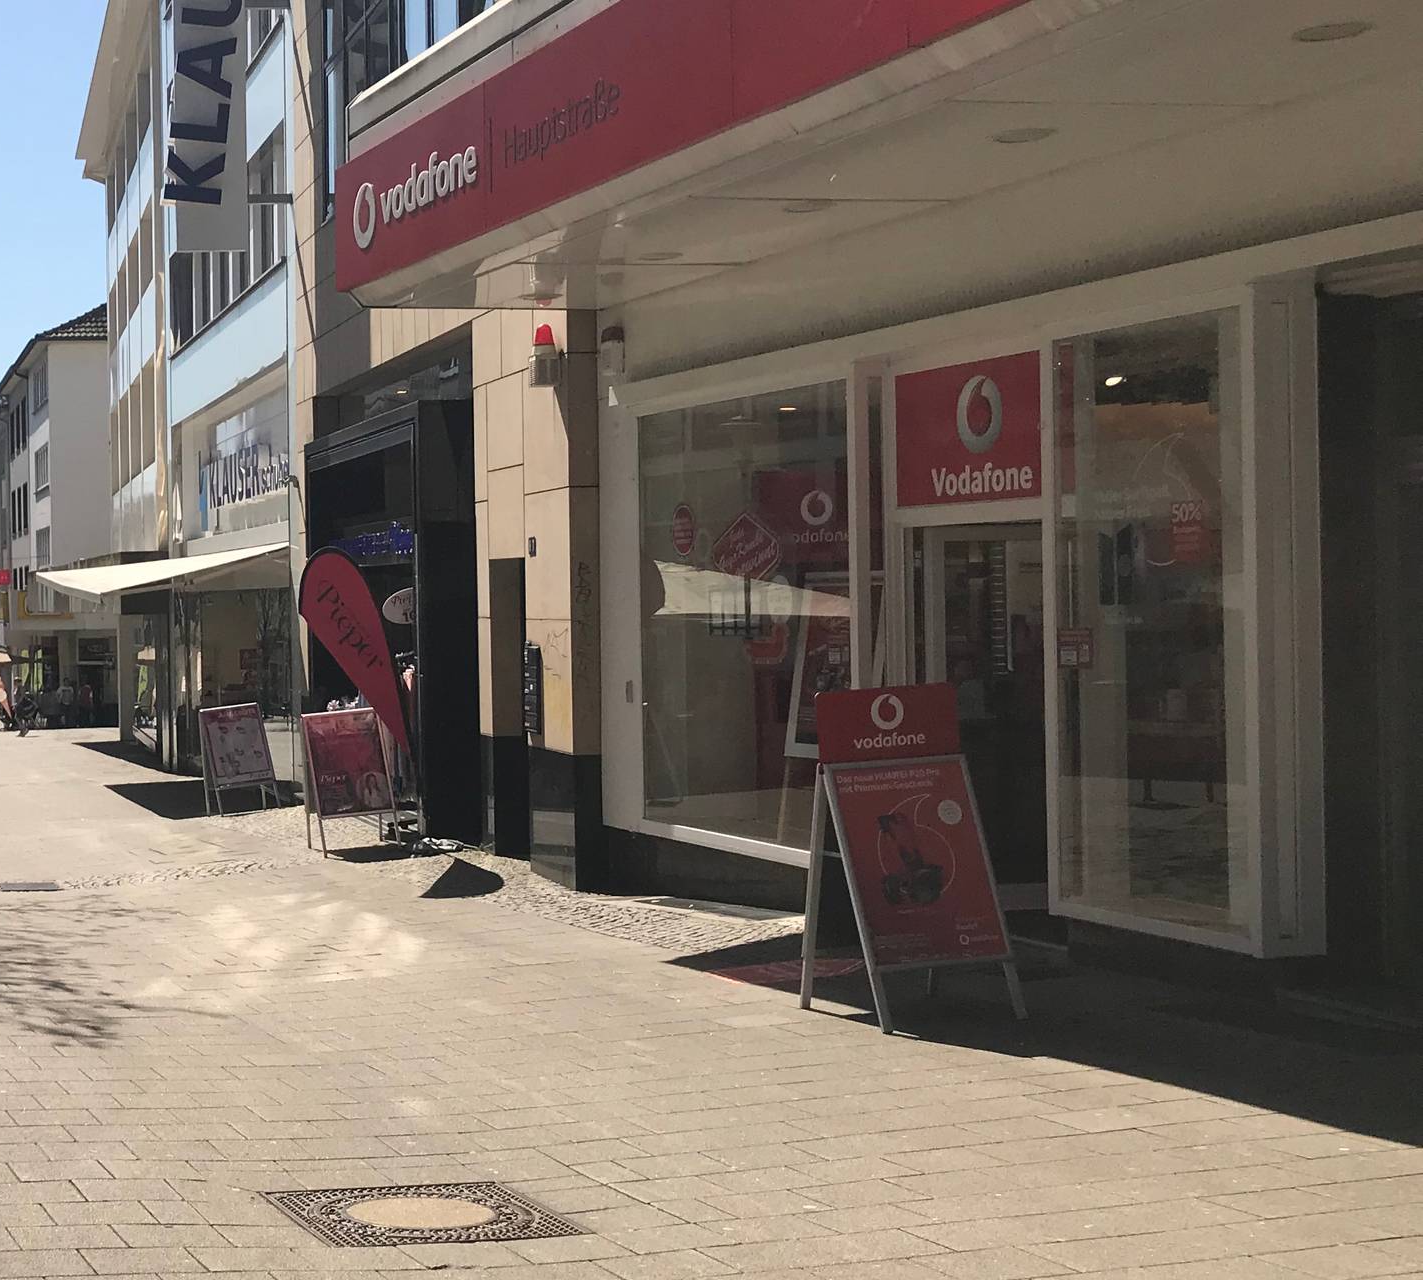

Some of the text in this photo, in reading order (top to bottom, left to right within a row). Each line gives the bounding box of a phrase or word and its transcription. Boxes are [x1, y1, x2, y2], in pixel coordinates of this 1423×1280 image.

[379, 78, 623, 224] vodafone Hauptstraße
[209, 444, 260, 509] KLAUSER
[930, 462, 1034, 498] Vodafone
[1170, 503, 1203, 523] 50%
[316, 579, 384, 669] Pieper
[853, 731, 926, 750] vodafone
